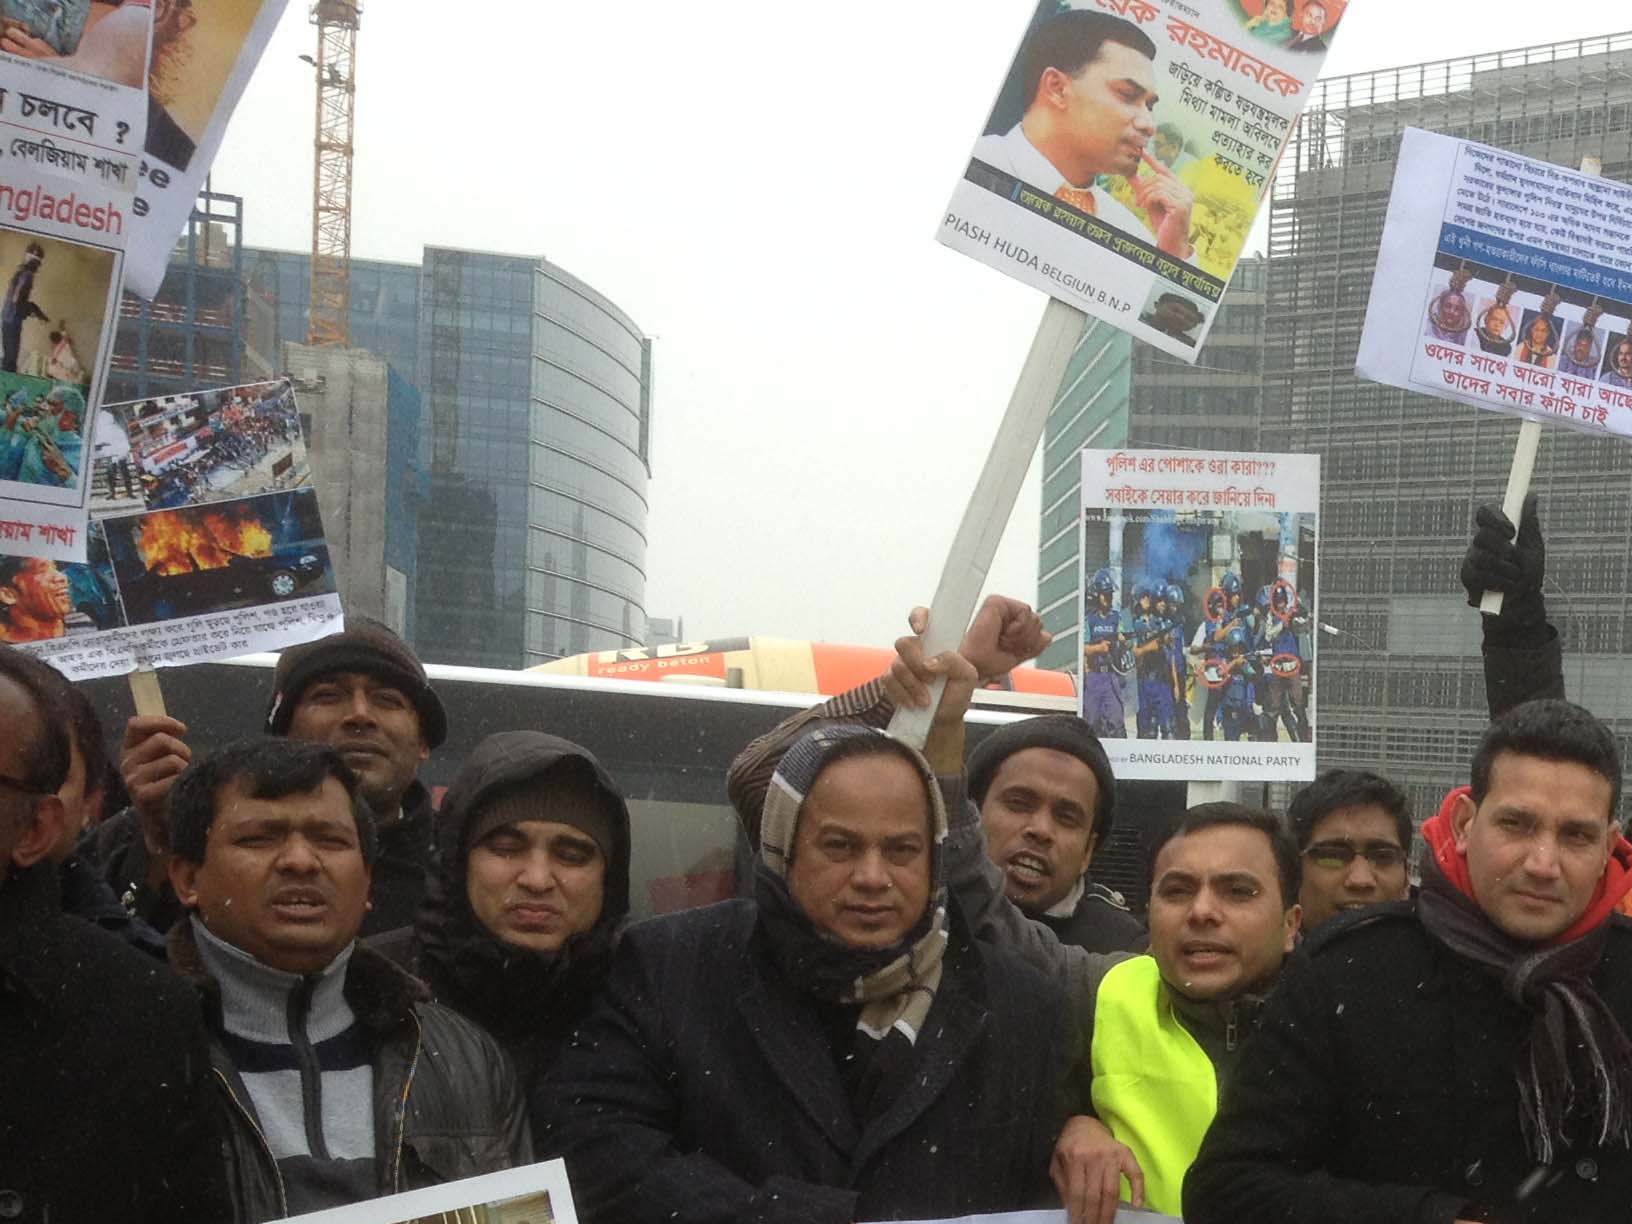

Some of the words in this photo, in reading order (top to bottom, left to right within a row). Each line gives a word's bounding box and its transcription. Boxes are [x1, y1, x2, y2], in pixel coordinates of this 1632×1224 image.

[1166, 15, 1304, 97] রহমানকে
[18, 92, 98, 135] চলবে
[11, 138, 89, 174] বেলজিয়াম
[92, 156, 128, 183] শাখা
[1214, 153, 1244, 175] করতে
[944, 214, 991, 246] PIASH
[993, 236, 1039, 270] HUDA
[1041, 263, 1096, 297] BELGIUN
[1425, 342, 1466, 366] ওদের
[1470, 354, 1508, 377] সাথে
[1512, 365, 1556, 390] আরো
[1561, 377, 1593, 400] যারা
[1442, 369, 1491, 395] তাদের
[1496, 384, 1535, 408] সবার
[1540, 392, 1577, 418] ফাঁসি
[1581, 405, 1609, 428] চাই
[1106, 452, 1136, 476] পুলিশ
[1139, 457, 1154, 472] এর
[1158, 457, 1205, 475] পোশাকে
[1208, 459, 1227, 475] ওরা
[1187, 491, 1209, 505] করে
[598, 662, 650, 674] ready
[657, 656, 710, 669] beton
[1129, 753, 1204, 765] BANGLADESH
[1207, 755, 1263, 766] NATIONAL
[1267, 755, 1301, 767] PARTY
